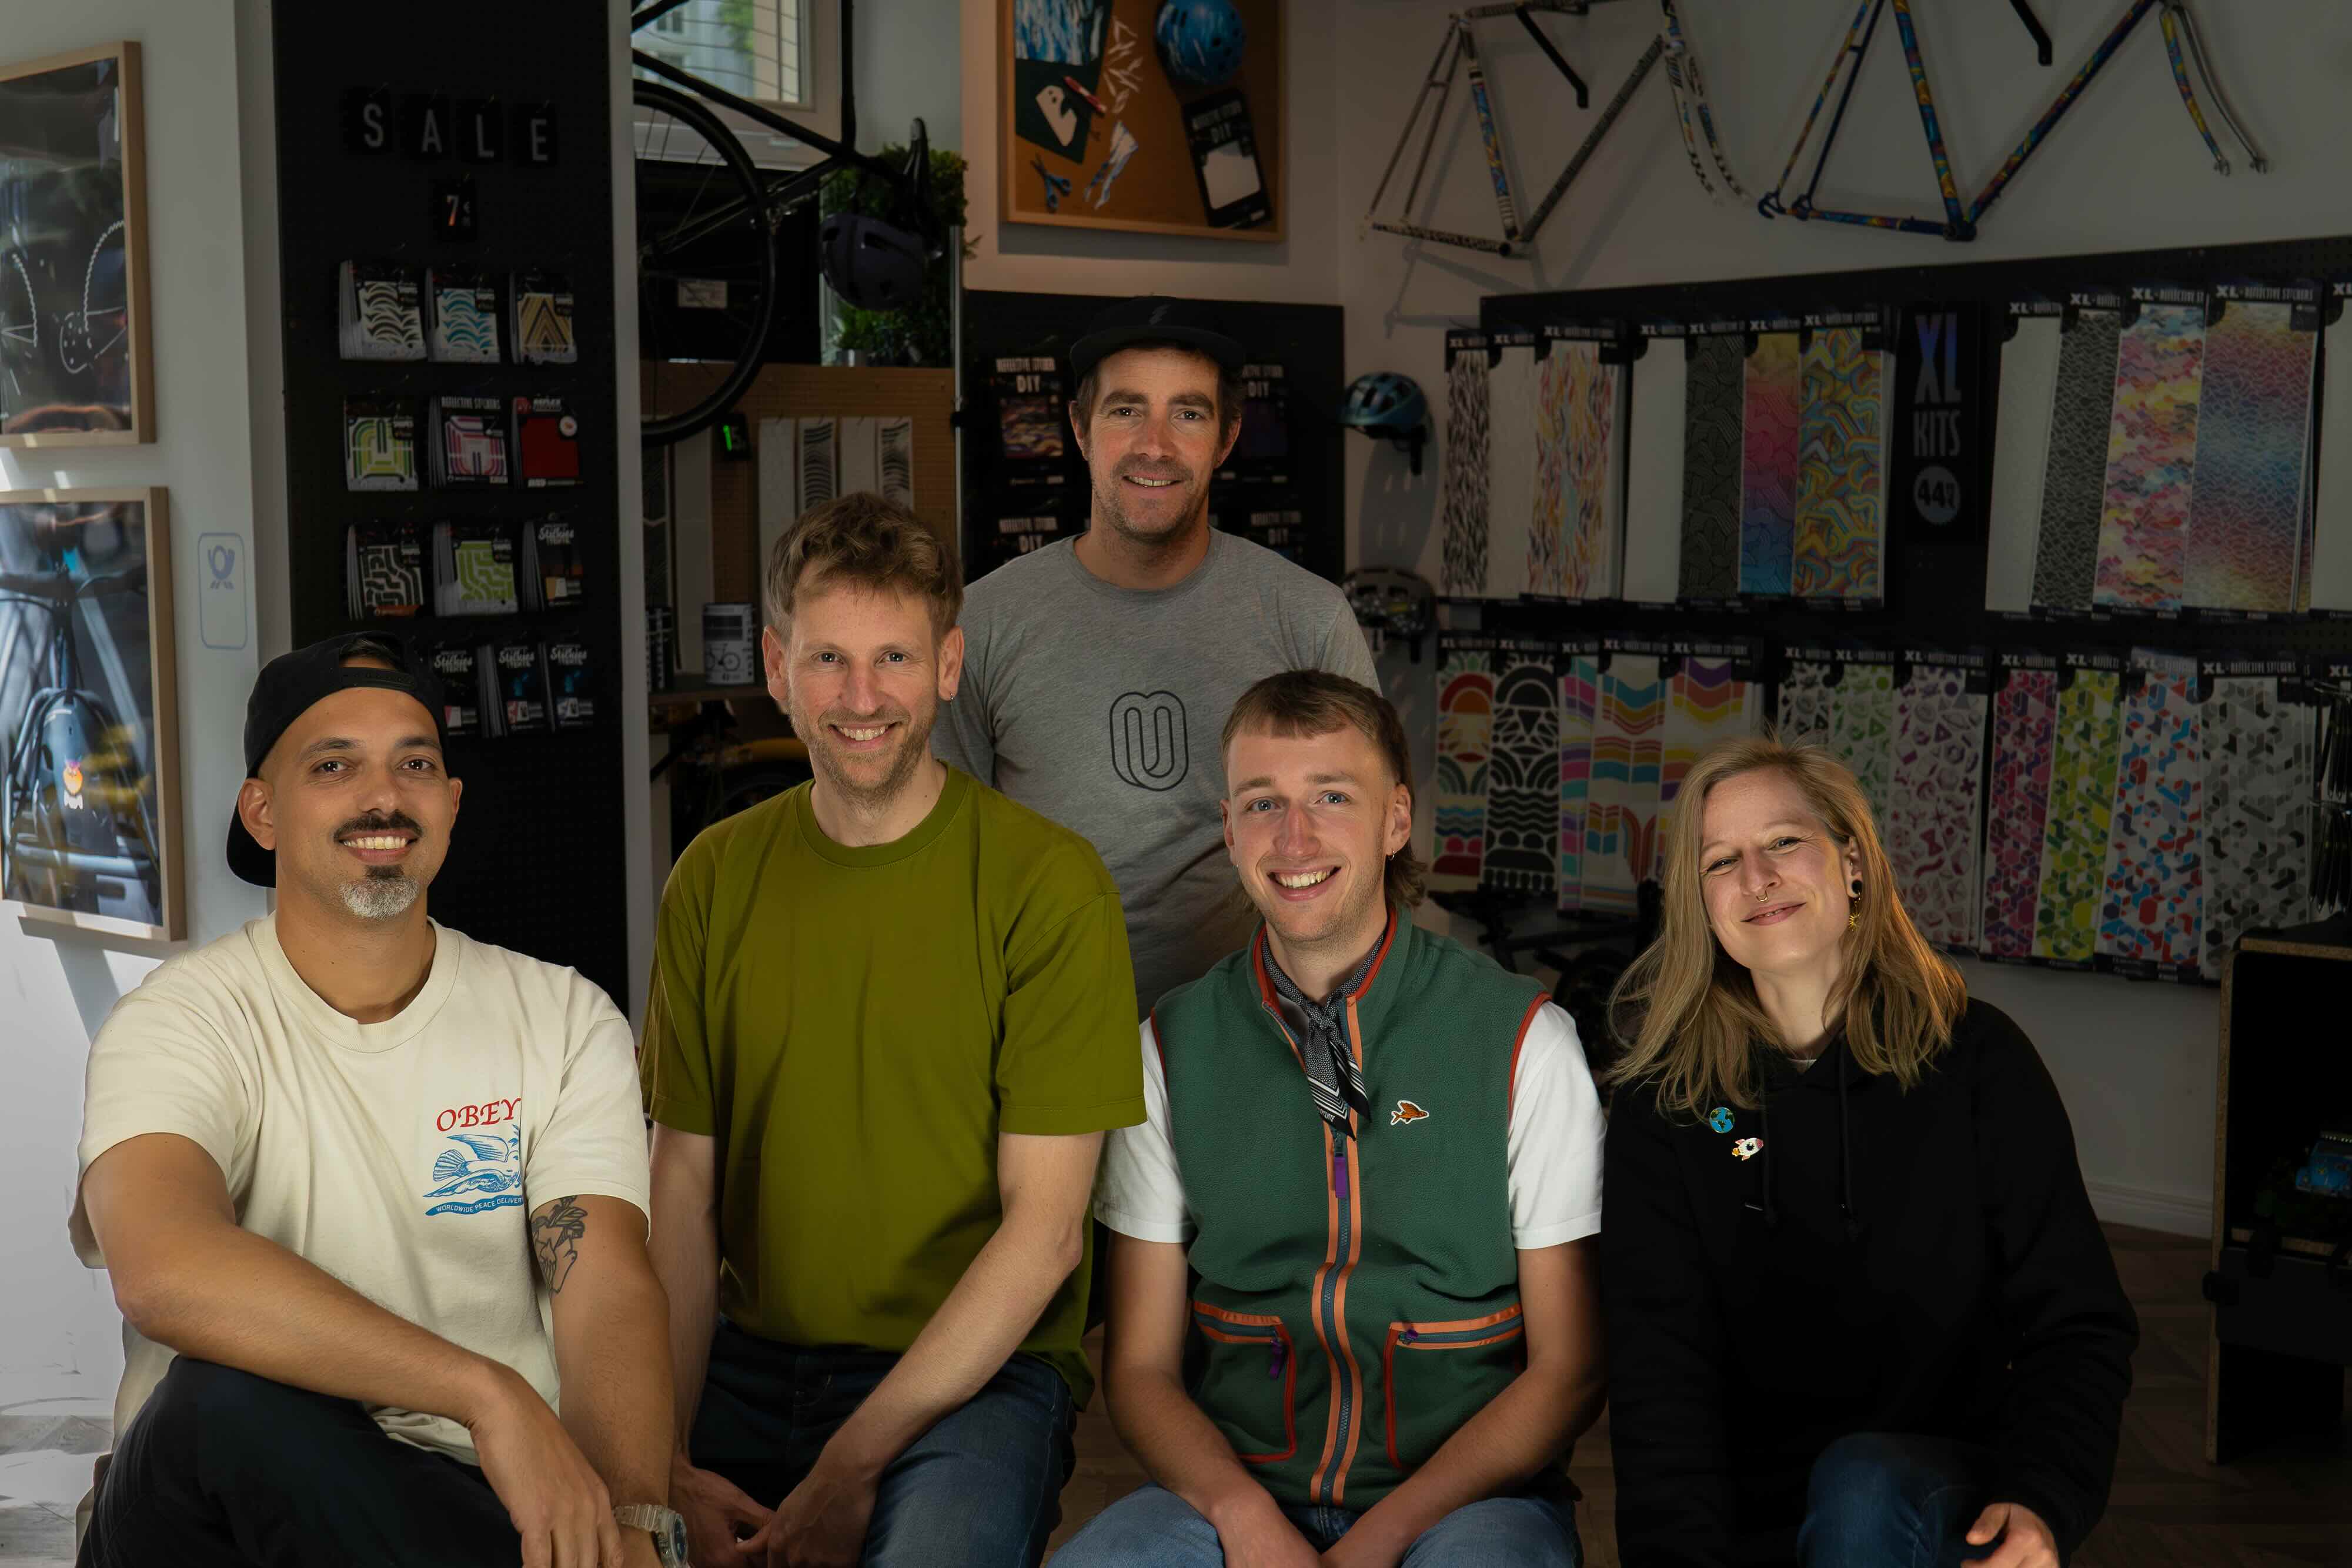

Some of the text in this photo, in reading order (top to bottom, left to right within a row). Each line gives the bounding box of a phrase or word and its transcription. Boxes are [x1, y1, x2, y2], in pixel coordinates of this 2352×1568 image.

[362, 103, 549, 163] SALE
[2132, 287, 2153, 300] XL
[2216, 285, 2239, 298] XL
[2070, 293, 2091, 306] XL
[2010, 302, 2029, 314] XL
[1749, 320, 1768, 331] XL
[1805, 315, 1822, 326] XL
[1544, 326, 1561, 337] XL
[1641, 325, 1656, 335] XL
[1690, 323, 1706, 335] XL
[1495, 335, 1511, 344] XL
[1914, 312, 1961, 404] XL
[1016, 375, 1040, 393] DIY
[1913, 410, 1960, 456] KITS
[1441, 638, 1456, 648] XL
[1562, 643, 1579, 653] XL
[1604, 639, 1619, 650] XL
[1673, 643, 1690, 653] XL
[1836, 650, 1853, 661] XL
[1905, 650, 1922, 662] XL
[2002, 654, 2021, 667] XL
[2066, 653, 2087, 666] XL
[2203, 663, 2224, 674] XL
[2329, 665, 2352, 677] XL
[436, 1098, 522, 1132] OBEY
[436, 1205, 473, 1213] WORLDWIDE
[475, 1201, 495, 1210] PEACE
